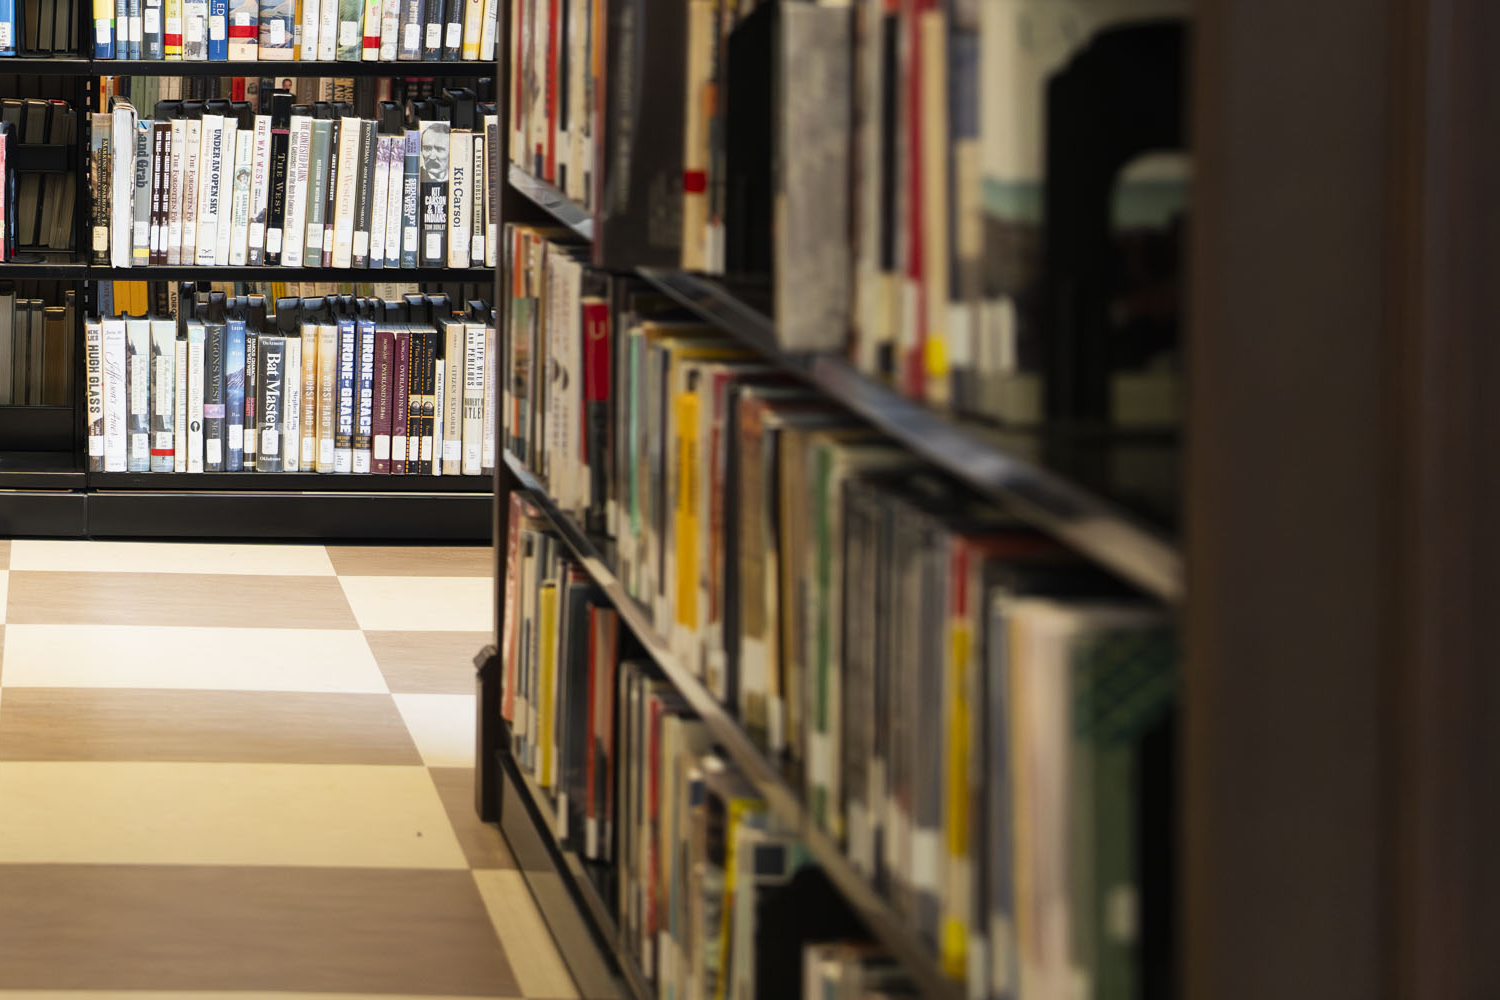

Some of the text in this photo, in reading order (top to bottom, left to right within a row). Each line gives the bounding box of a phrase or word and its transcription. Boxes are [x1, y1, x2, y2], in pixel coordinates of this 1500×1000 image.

[136, 160, 149, 188] Grab
[209, 129, 221, 216] UNDER AN OPEN SKY
[255, 120, 266, 186] THE WAY WEST
[275, 153, 285, 215] THE WEST
[431, 187, 441, 195] KIT
[453, 167, 463, 186] Kit
[424, 214, 446, 223] INDIANS
[425, 196, 446, 204] CARSON
[211, 327, 220, 402] WAGONS WEST
[266, 352, 281, 376] Bat
[342, 325, 354, 380] THRONE
[362, 325, 374, 381] THRONE
[467, 348, 475, 386] PERILOUS
[476, 342, 484, 361] LIFE
[88, 344, 100, 414] HUGH GLASS
[476, 365, 484, 386] WILD
[340, 387, 352, 434] GRACE
[360, 388, 372, 434] GRACE
